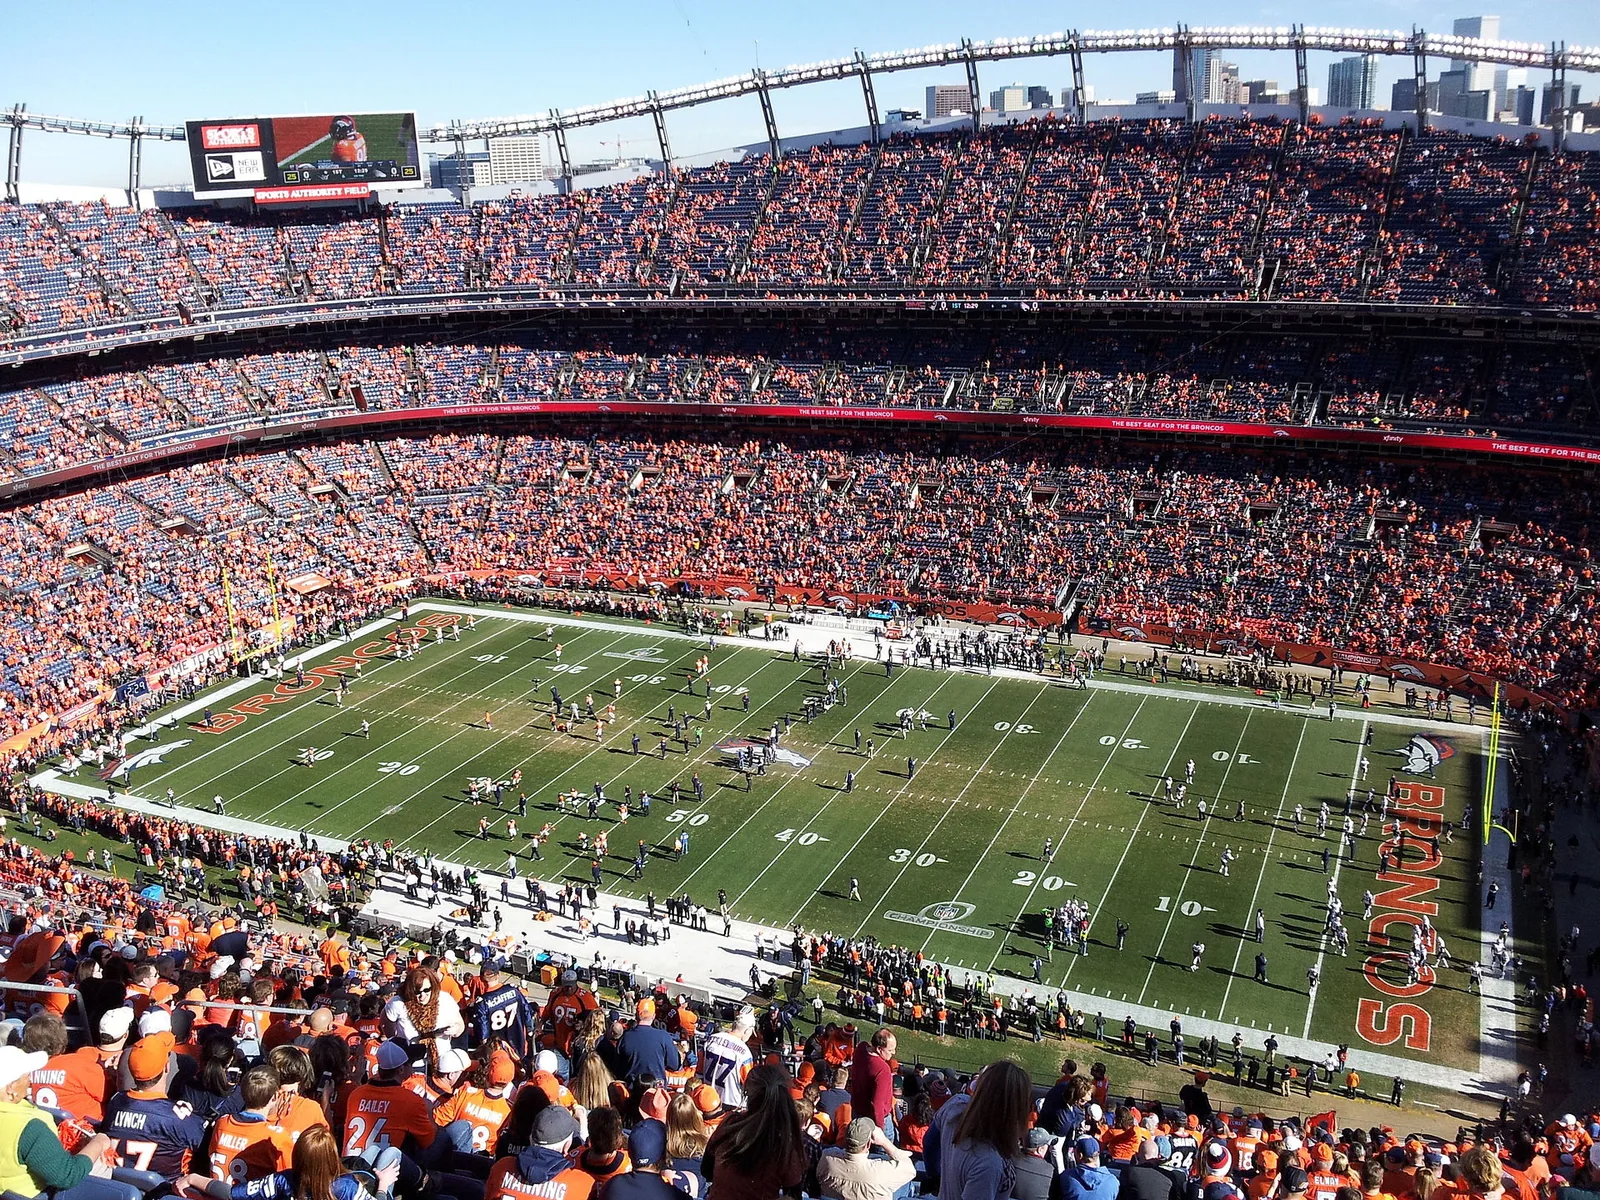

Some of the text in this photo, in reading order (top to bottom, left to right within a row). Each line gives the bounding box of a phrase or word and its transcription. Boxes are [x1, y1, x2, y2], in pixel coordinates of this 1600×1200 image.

[206, 127, 255, 141] SPORTS
[238, 159, 258, 167] NEW
[239, 167, 259, 175] ERA
[256, 185, 368, 200] SPORTS AUTHORITY FIELD
[722, 406, 737, 414] xfinity
[1023, 416, 1040, 424] xfinity
[104, 460, 120, 468] BEST
[123, 456, 138, 466] SEAT
[140, 453, 154, 462] FOR
[154, 450, 166, 459] THE
[168, 443, 197, 456] BRONCOS
[1508, 444, 1528, 452] BEST
[1530, 446, 1550, 454] SEAT
[1552, 448, 1568, 456] FOR
[1570, 450, 1585, 458] THE
[190, 653, 206, 666] TO
[1332, 652, 1381, 665] CHAMPIONSHIP
[190, 613, 460, 735] BRONCOS
[124, 682, 146, 698] 12:29
[994, 722, 1034, 735] 30
[1099, 736, 1142, 750] 20
[1212, 750, 1251, 765] 10
[378, 762, 420, 776] 20
[666, 810, 709, 827] 50
[774, 828, 819, 846] 40
[888, 848, 937, 868] 30
[1012, 870, 1064, 891] 20
[1154, 896, 1202, 917] 10
[1356, 780, 1446, 1052] BRONCOS
[168, 925, 179, 937] 18
[888, 912, 990, 939] CHAMPIONSHIP
[490, 1002, 518, 1030] 87
[554, 1006, 577, 1027] 95
[30, 1070, 66, 1085] ANNING
[705, 1051, 737, 1088] 77
[358, 1098, 390, 1114] BAILEY
[465, 1102, 504, 1125] MANNING
[114, 1110, 146, 1130] LYNCH
[219, 1132, 248, 1150] MILLER
[348, 1116, 392, 1157] 24
[472, 1126, 490, 1151] 8
[1172, 1152, 1194, 1168] 84
[1238, 1150, 1254, 1171] 18
[210, 1152, 248, 1186] 58
[1314, 1176, 1340, 1186] ELWAY
